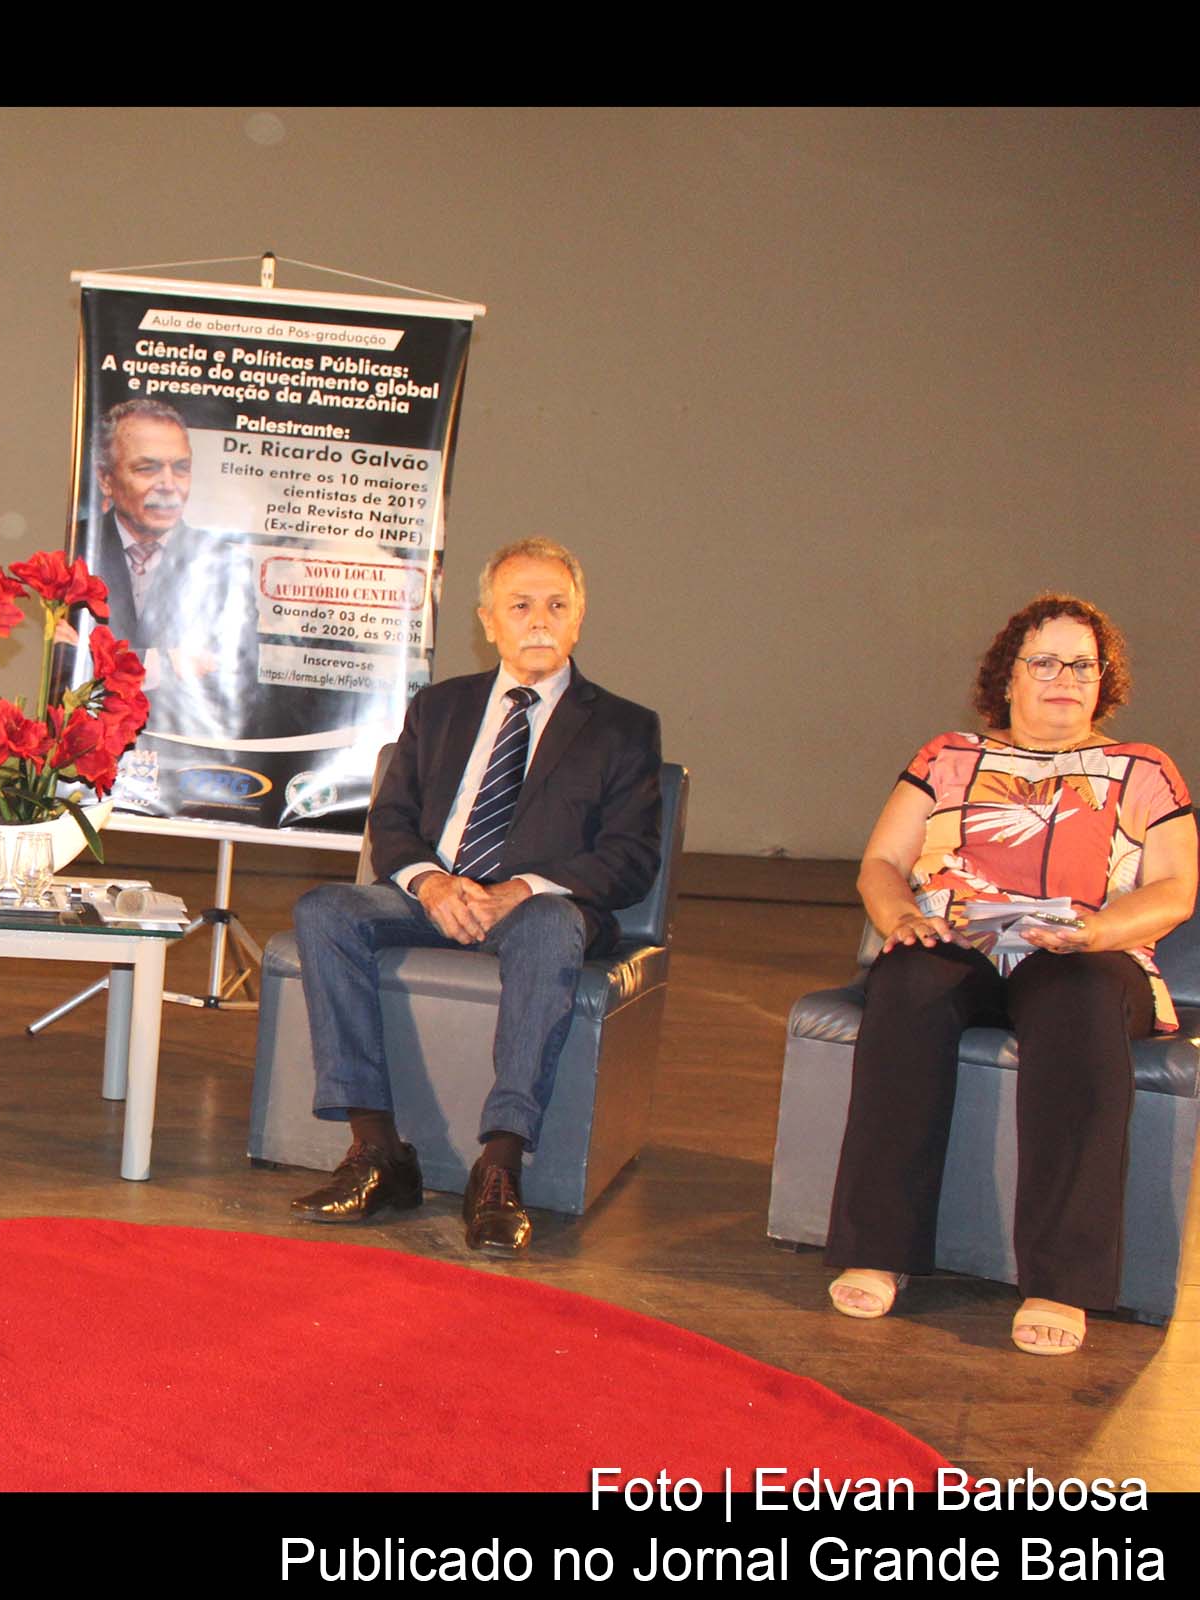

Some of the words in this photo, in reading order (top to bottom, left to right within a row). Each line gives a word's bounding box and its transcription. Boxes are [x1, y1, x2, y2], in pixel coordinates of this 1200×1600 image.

[151, 315, 182, 327] Aula
[186, 317, 202, 329] de
[206, 320, 263, 334] abertura
[267, 323, 284, 336] da
[135, 339, 207, 361] Ciência
[213, 350, 226, 362] e
[231, 347, 314, 371] Políticas
[319, 355, 409, 379] Públicas:
[101, 354, 117, 371] A
[122, 359, 202, 378] questão
[208, 363, 234, 381] do
[240, 368, 369, 393] aquecimento
[375, 378, 440, 400] global
[128, 377, 141, 390] e
[146, 379, 270, 403] preservação
[275, 386, 302, 404] da
[307, 389, 410, 414] Amazônia
[235, 414, 351, 440] Palestrante:
[223, 436, 252, 455] Dr.
[261, 440, 342, 463] Ricardo
[351, 448, 429, 471] Galvão
[221, 461, 264, 477] Eleito
[269, 469, 312, 482] entre
[317, 474, 334, 484] os
[341, 473, 359, 486] 10
[364, 477, 428, 493] maiores
[283, 484, 357, 504] cientistas
[362, 492, 382, 505] de
[387, 495, 427, 509] 2019
[266, 501, 301, 515] pela
[307, 504, 363, 521] Revista
[369, 510, 425, 526] Nature
[264, 517, 349, 536] (Ex-diretor
[354, 526, 374, 538] do
[380, 528, 423, 545] INPE)
[304, 565, 341, 580] NOVO
[345, 568, 386, 582] LOCAL
[274, 582, 349, 599] AUDITÓRIO
[272, 604, 335, 620] Quando?
[339, 611, 356, 622] 03
[360, 613, 377, 624] de
[381, 616, 423, 630] maço
[301, 623, 317, 634] de
[322, 624, 359, 640] 2020,
[303, 654, 375, 670] Inscreva-se
